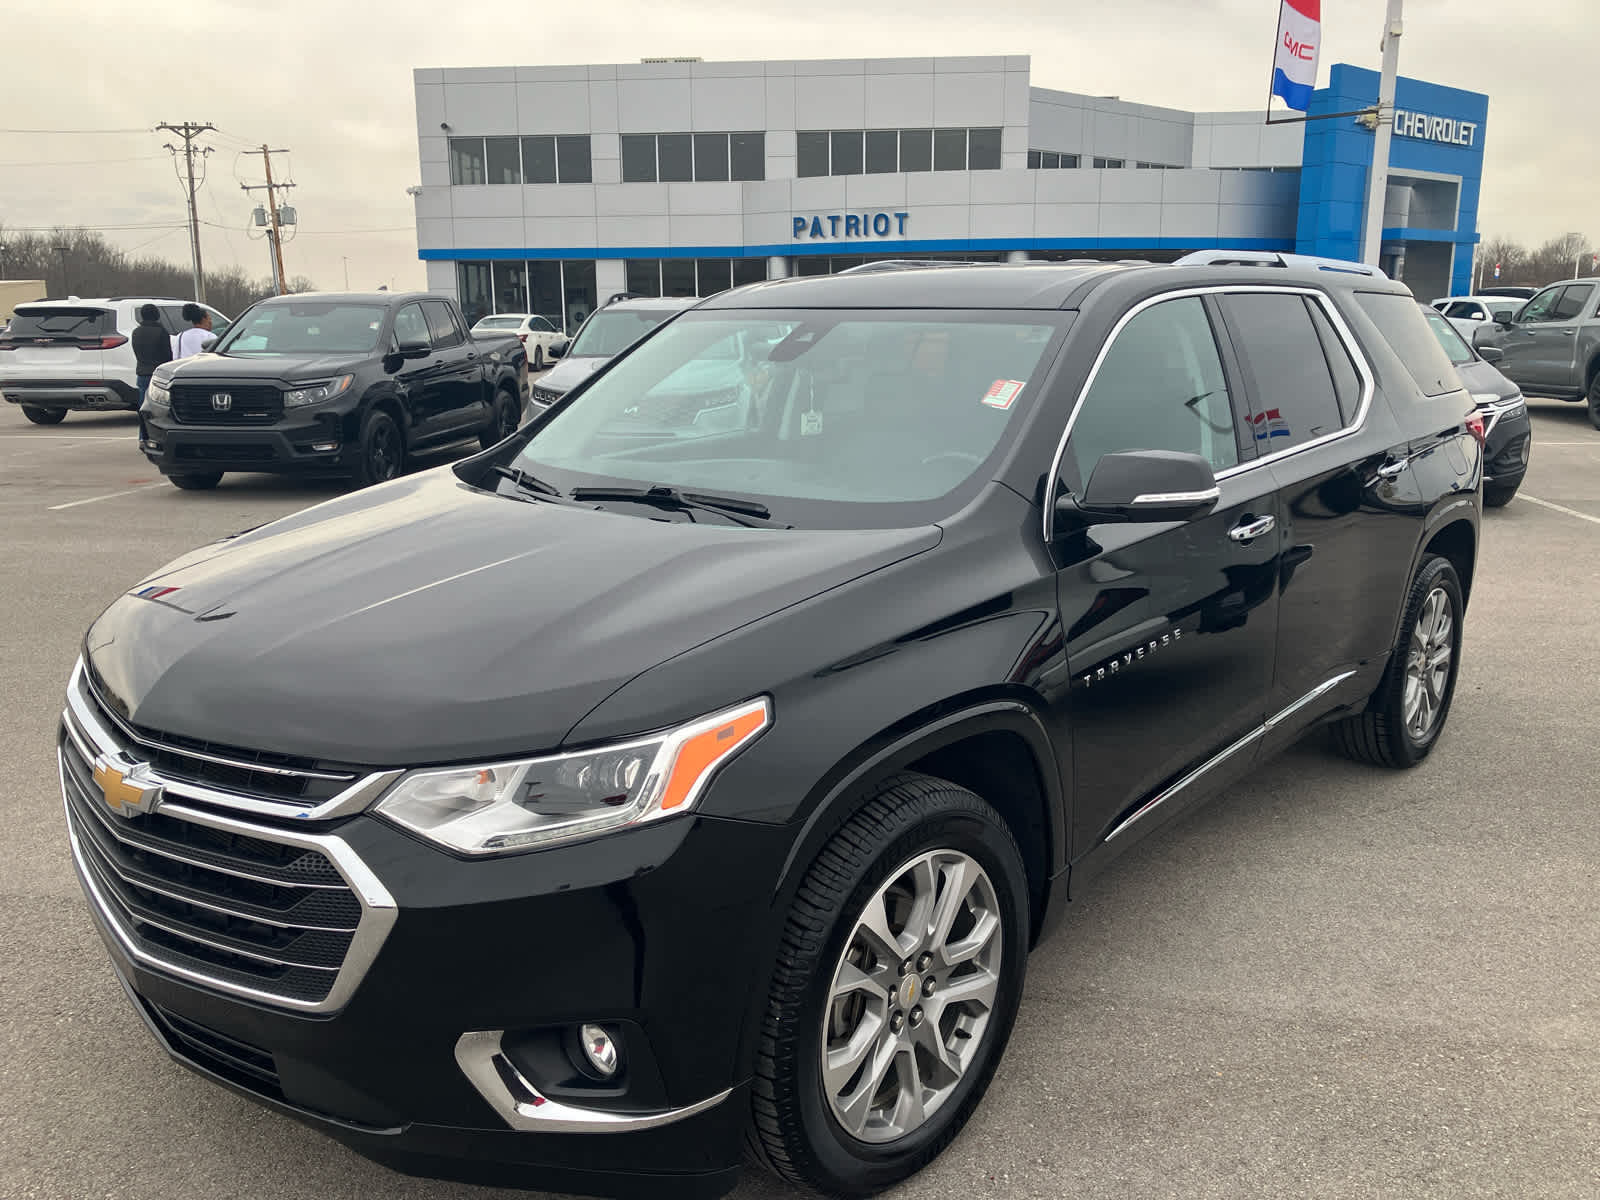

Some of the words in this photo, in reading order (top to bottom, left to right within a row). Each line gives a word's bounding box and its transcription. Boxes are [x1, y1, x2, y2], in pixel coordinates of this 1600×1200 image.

[1394, 110, 1477, 146] CHEVROLET
[793, 212, 909, 239] PATRIOT
[1083, 628, 1182, 688] TRAVERSE
